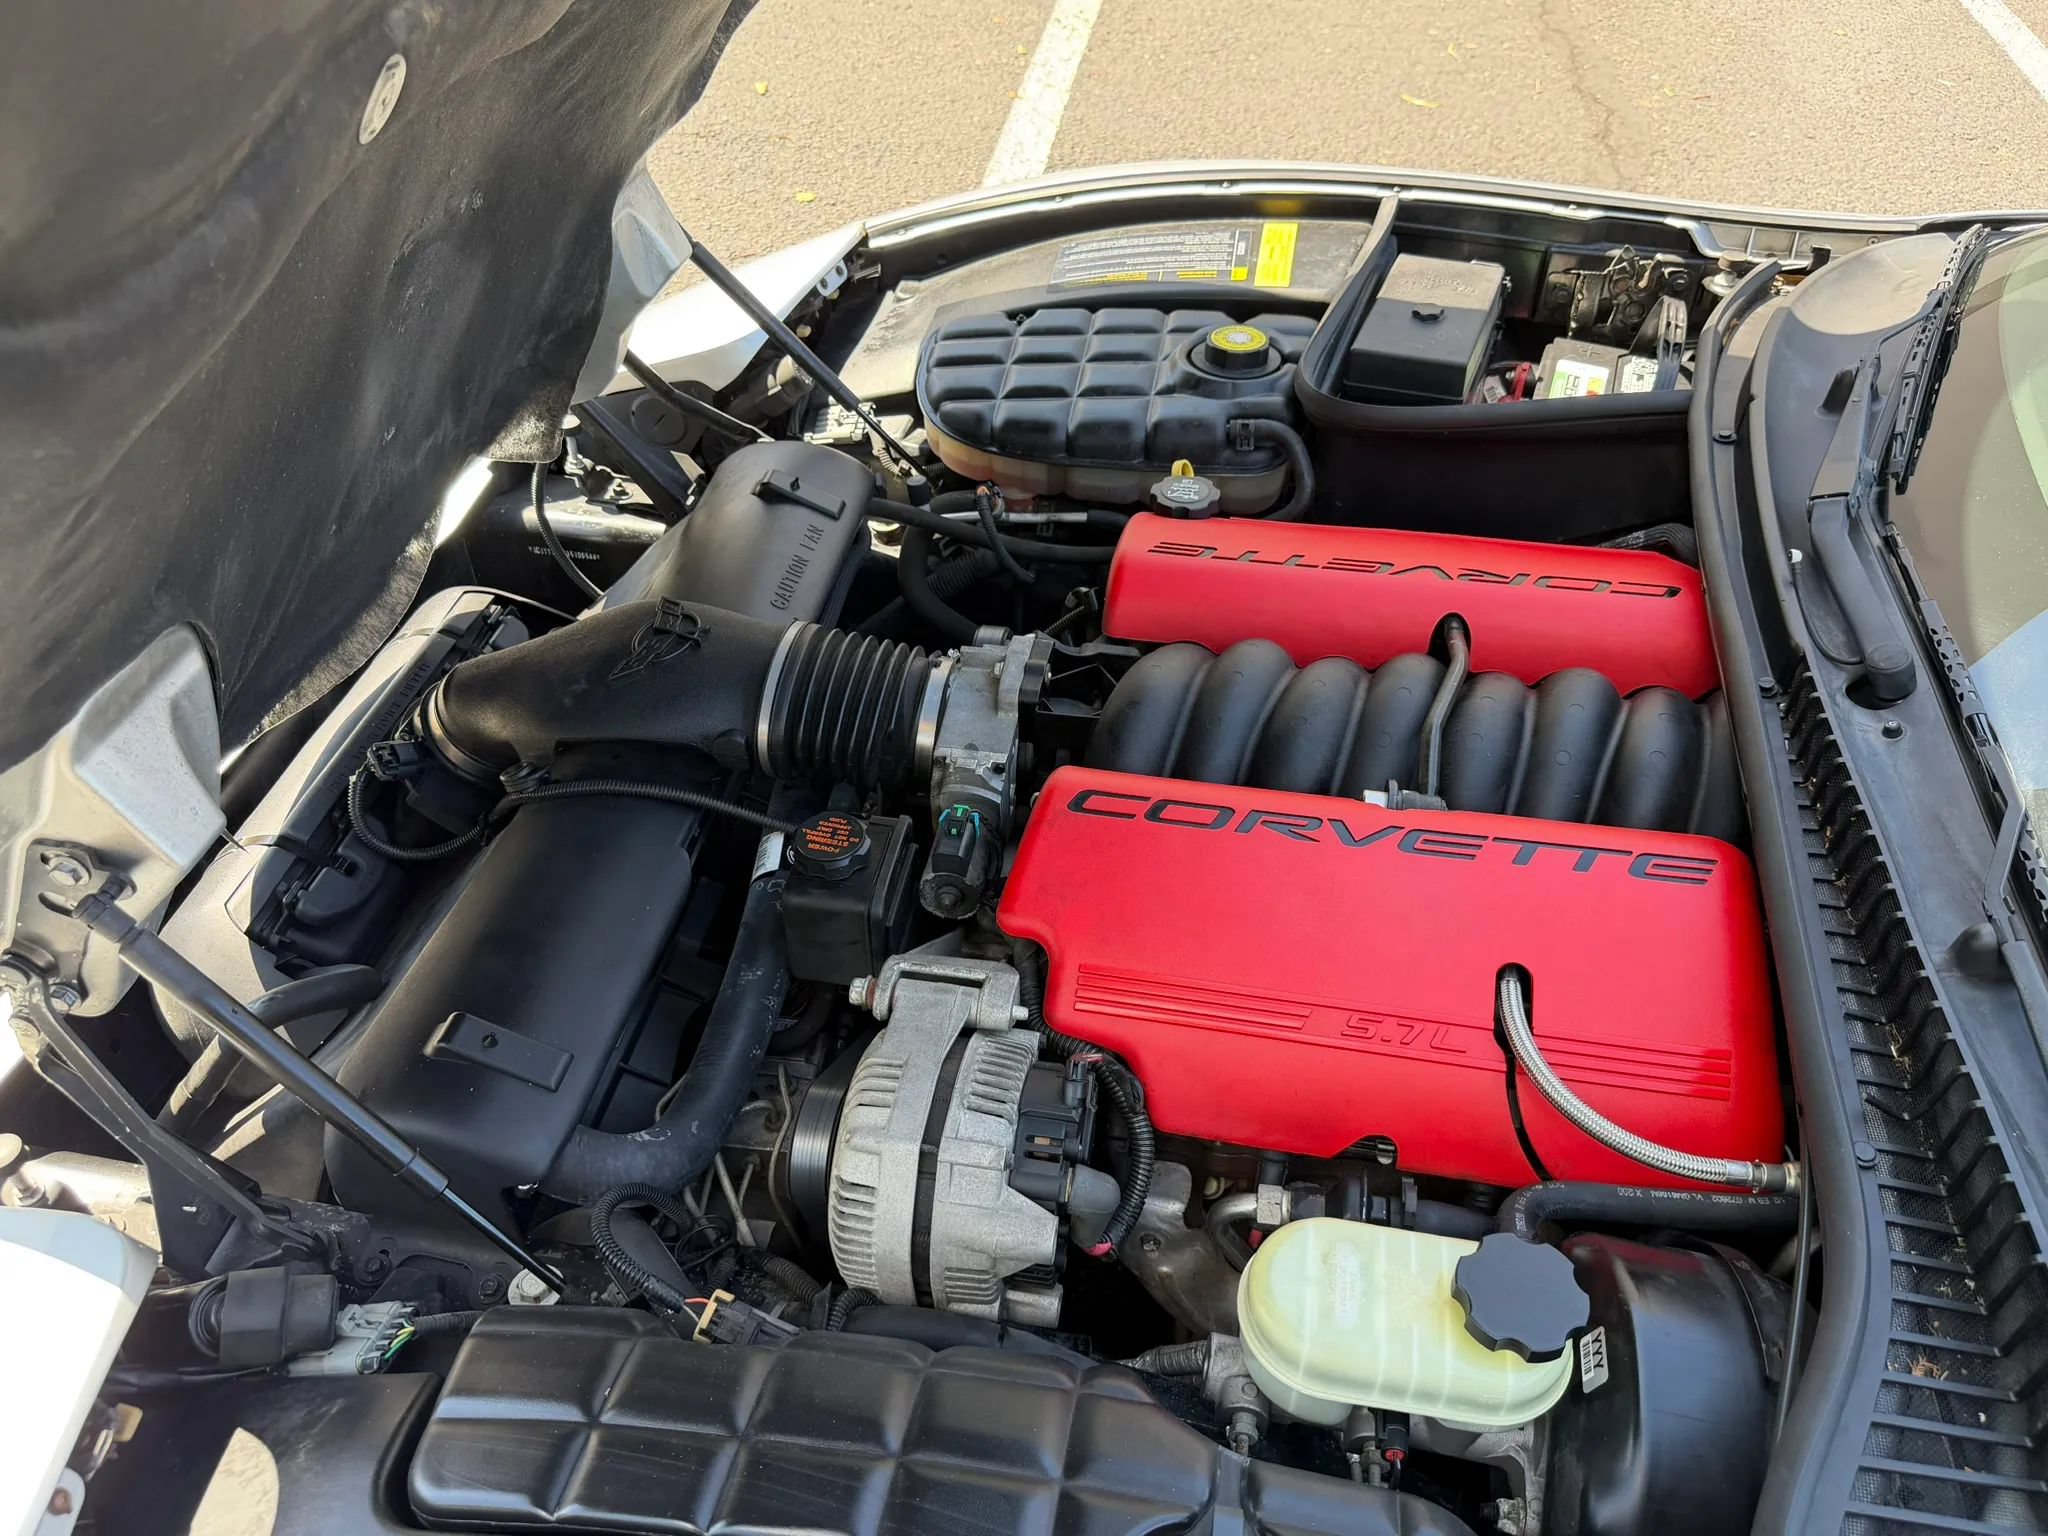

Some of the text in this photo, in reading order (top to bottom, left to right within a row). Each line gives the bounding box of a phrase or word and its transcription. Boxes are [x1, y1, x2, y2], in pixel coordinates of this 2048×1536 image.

[770, 523, 824, 610] CAUTION FAN
[1147, 541, 1683, 599] CORVETTE
[806, 834, 849, 847] STEERING
[807, 842, 840, 854] POWER
[1066, 789, 1719, 886] CORVETTE
[1340, 1013, 1467, 1054] 5.7L
[1591, 1330, 1605, 1369] YYY
